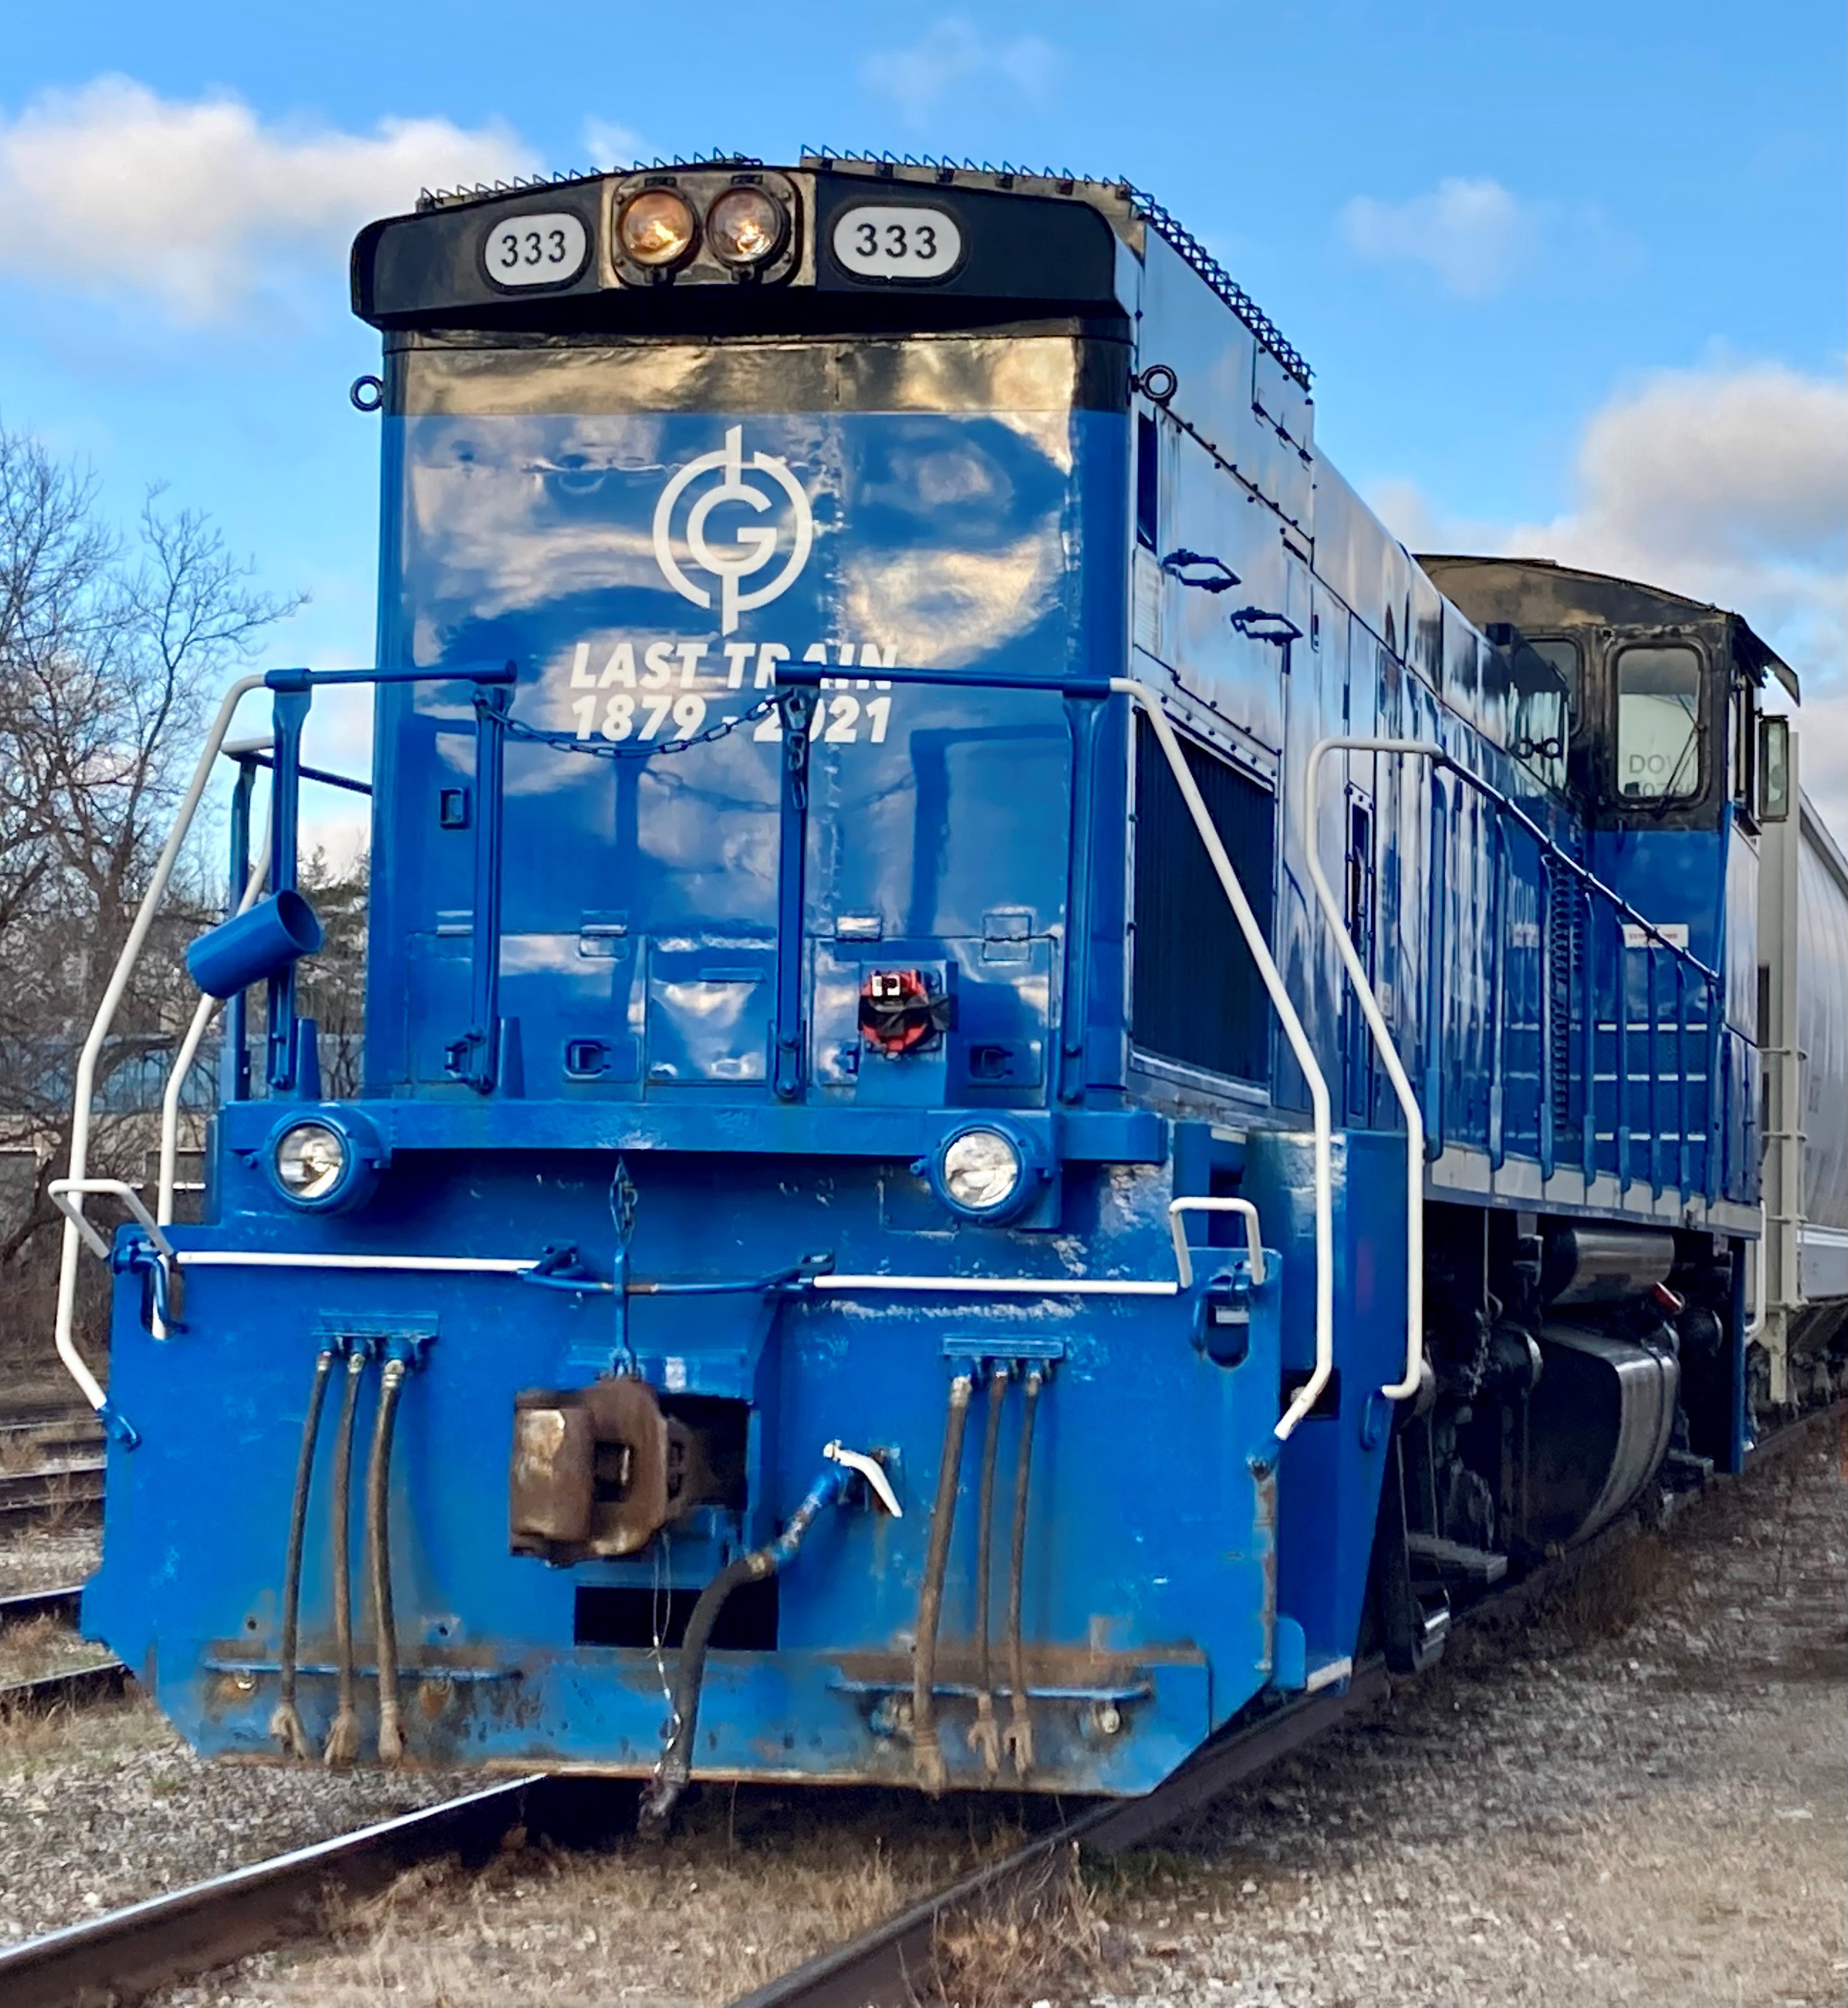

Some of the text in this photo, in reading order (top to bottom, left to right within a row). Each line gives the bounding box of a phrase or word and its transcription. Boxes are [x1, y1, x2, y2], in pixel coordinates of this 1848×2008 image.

[501, 230, 566, 268] 333
[855, 222, 937, 260] 333
[570, 641, 709, 689] LAST
[571, 693, 707, 742] 1879
